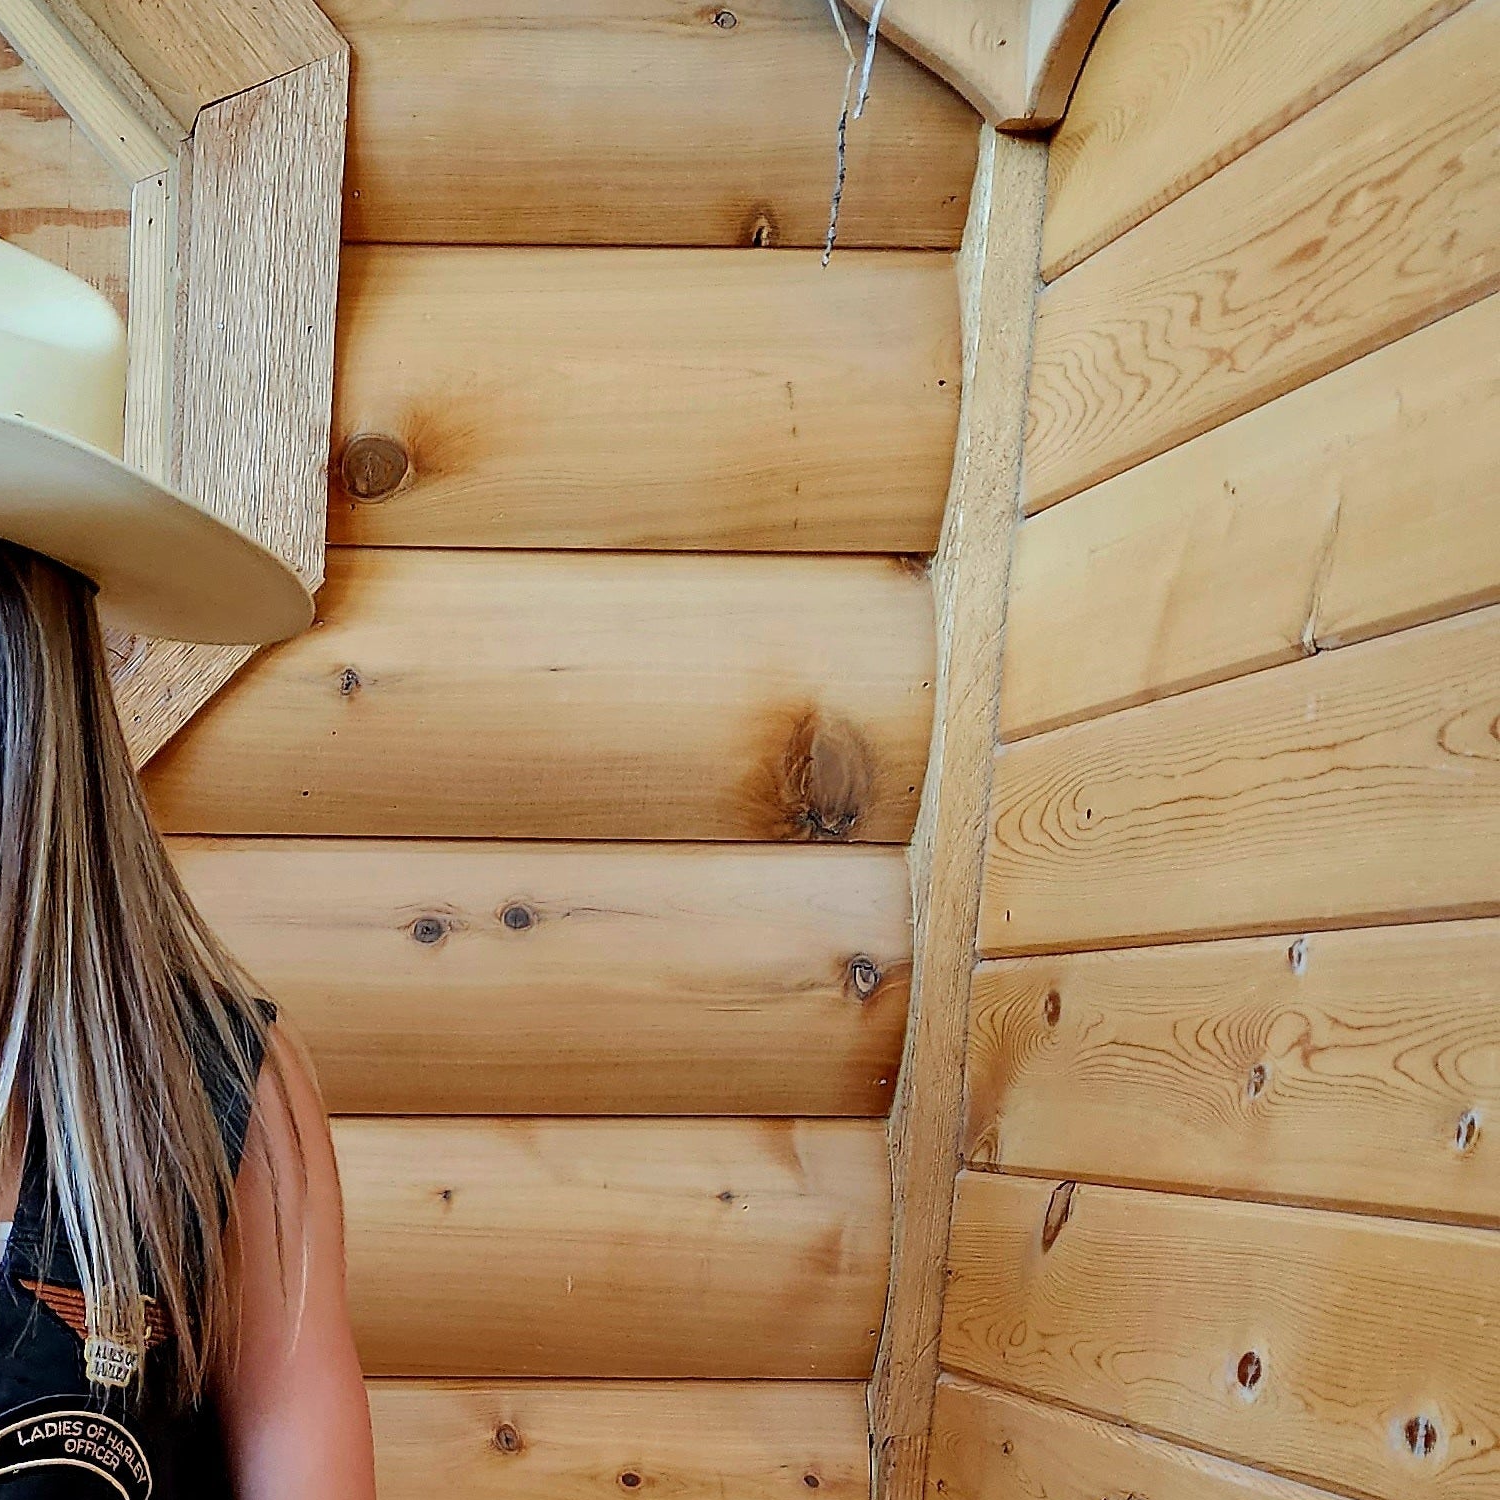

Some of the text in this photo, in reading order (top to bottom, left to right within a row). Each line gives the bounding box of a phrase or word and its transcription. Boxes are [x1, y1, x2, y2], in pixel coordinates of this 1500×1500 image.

[17, 1421, 147, 1484] LADIES OF HARLEY
[64, 1438, 120, 1472] OFFICER
